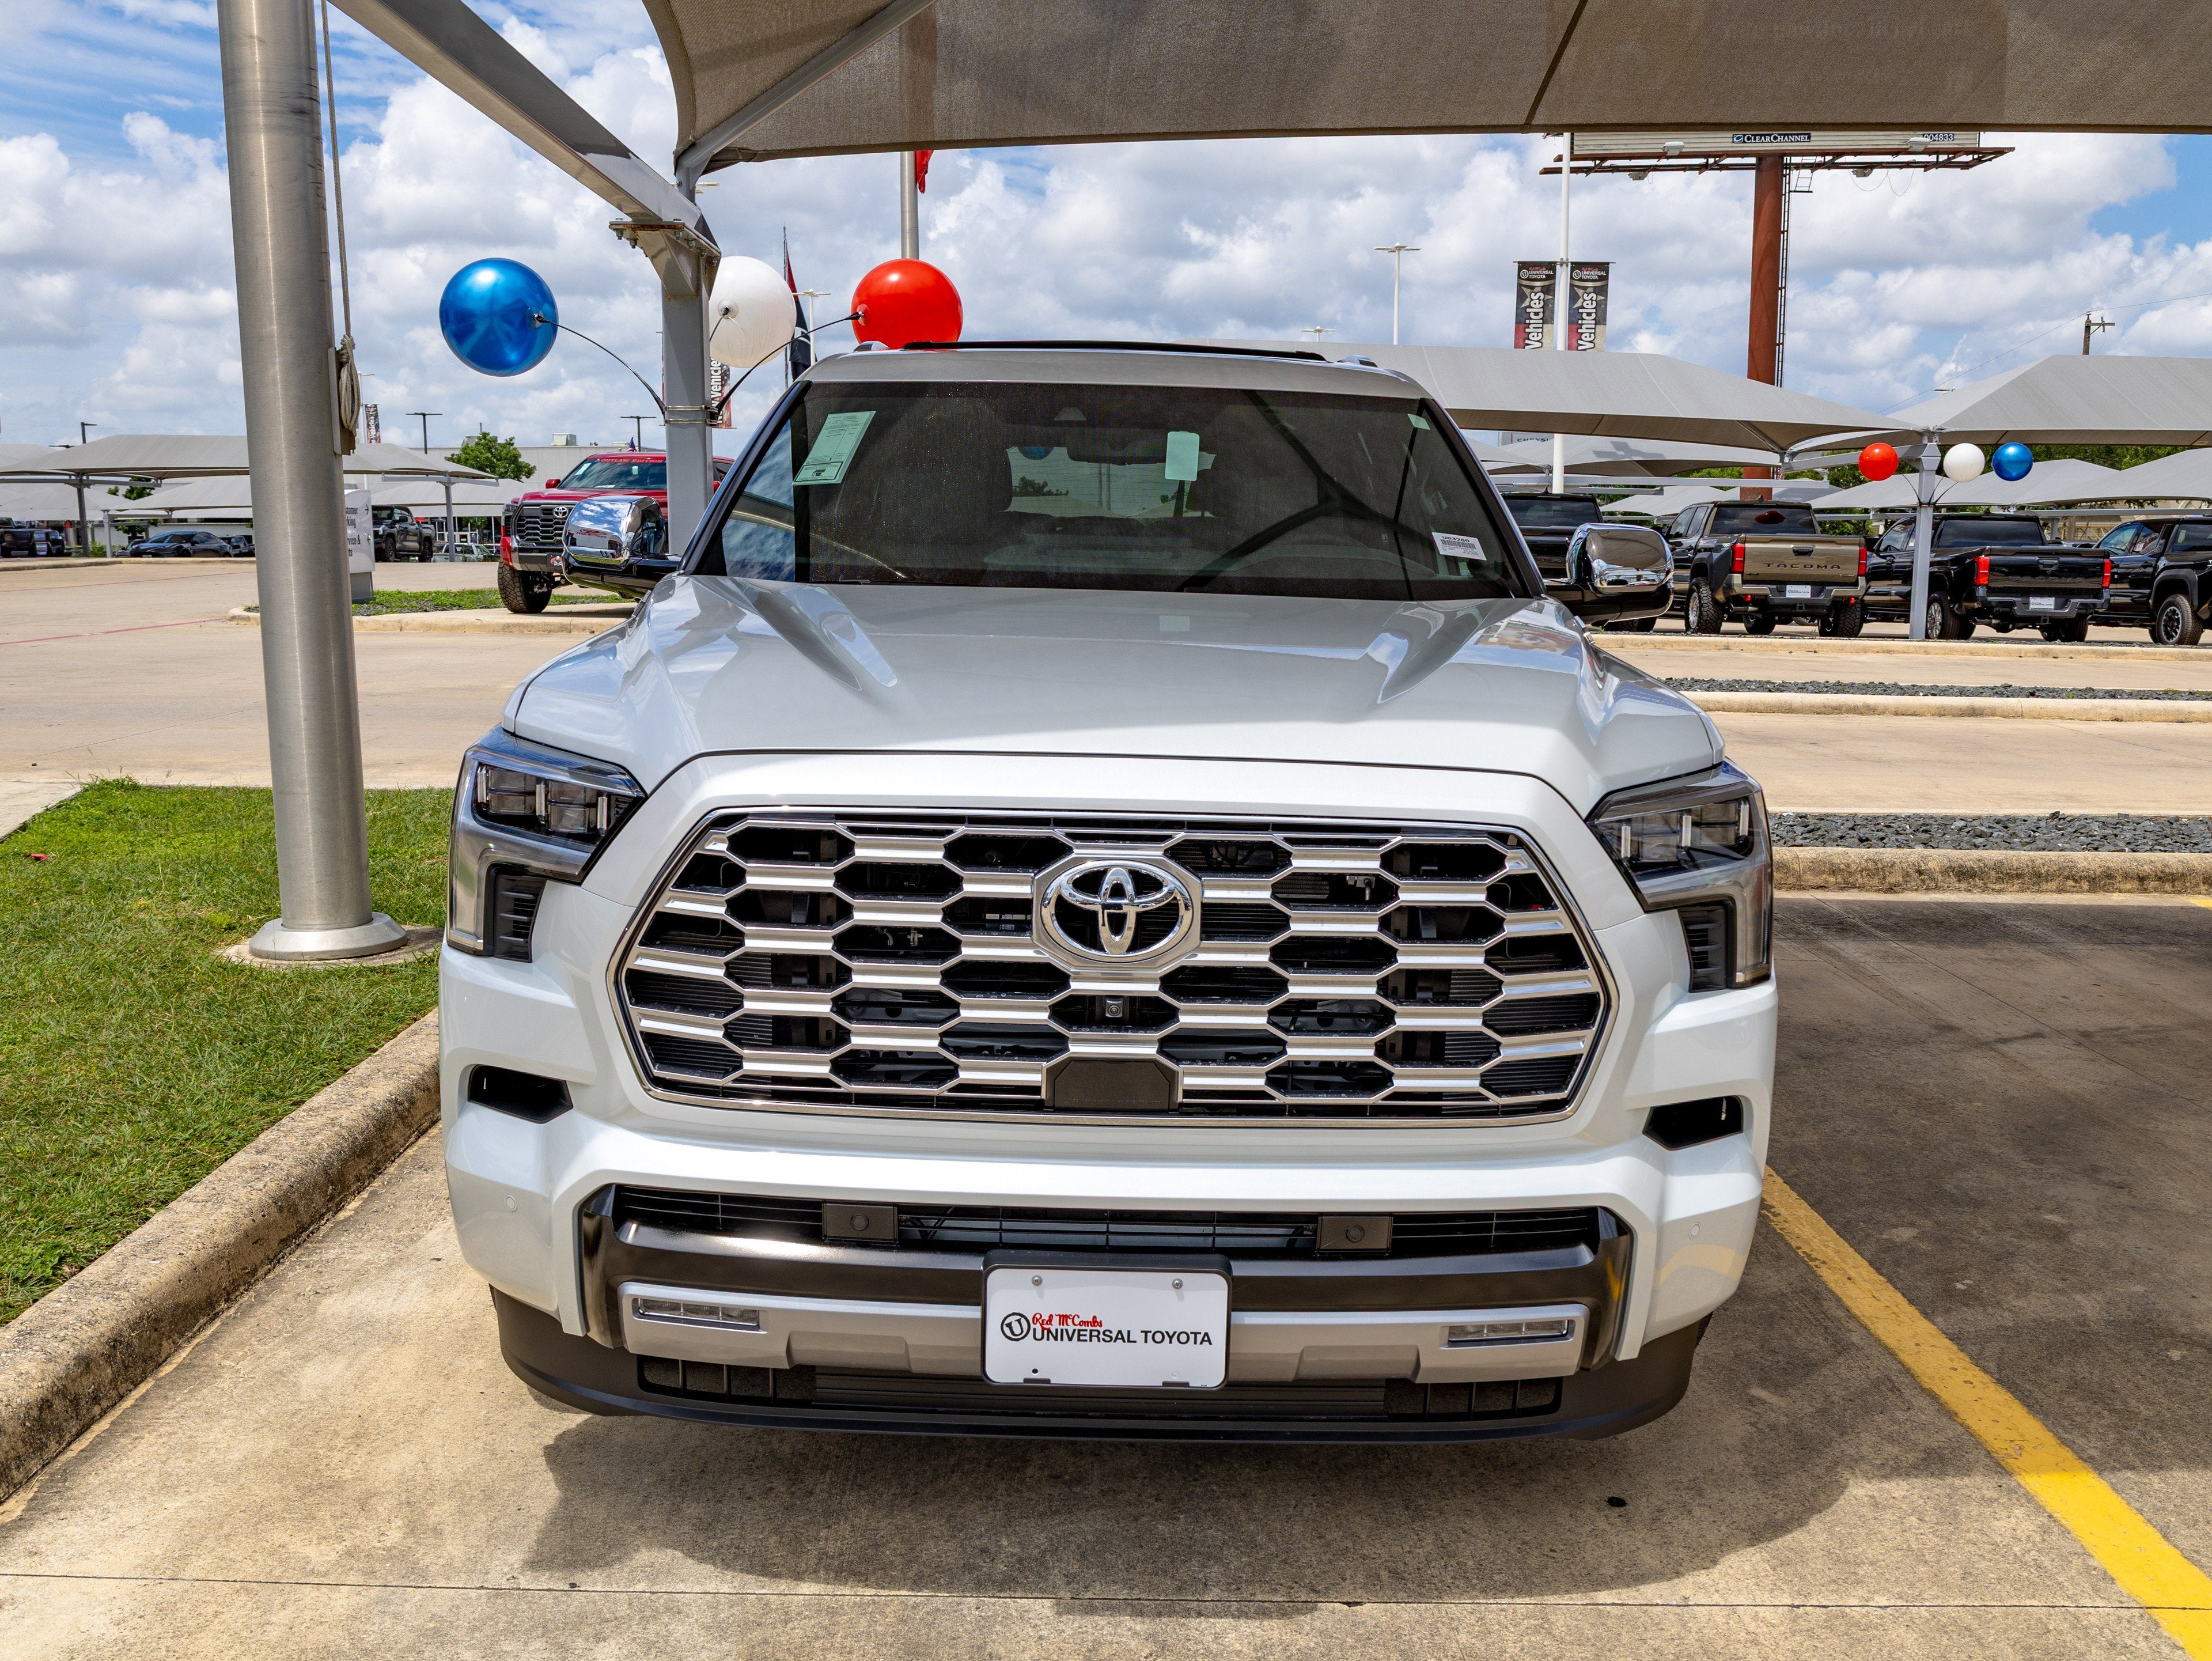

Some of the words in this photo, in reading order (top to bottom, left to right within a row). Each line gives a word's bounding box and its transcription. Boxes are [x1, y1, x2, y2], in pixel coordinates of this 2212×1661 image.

[1525, 292, 1544, 350] Vehicles
[1577, 293, 1597, 350] Vehicles
[1032, 1312, 1054, 1330] Red
[1055, 1313, 1103, 1327] McCombs
[1032, 1327, 1137, 1344] UNIVERSAL
[1141, 1330, 1213, 1345] TOYOTA
